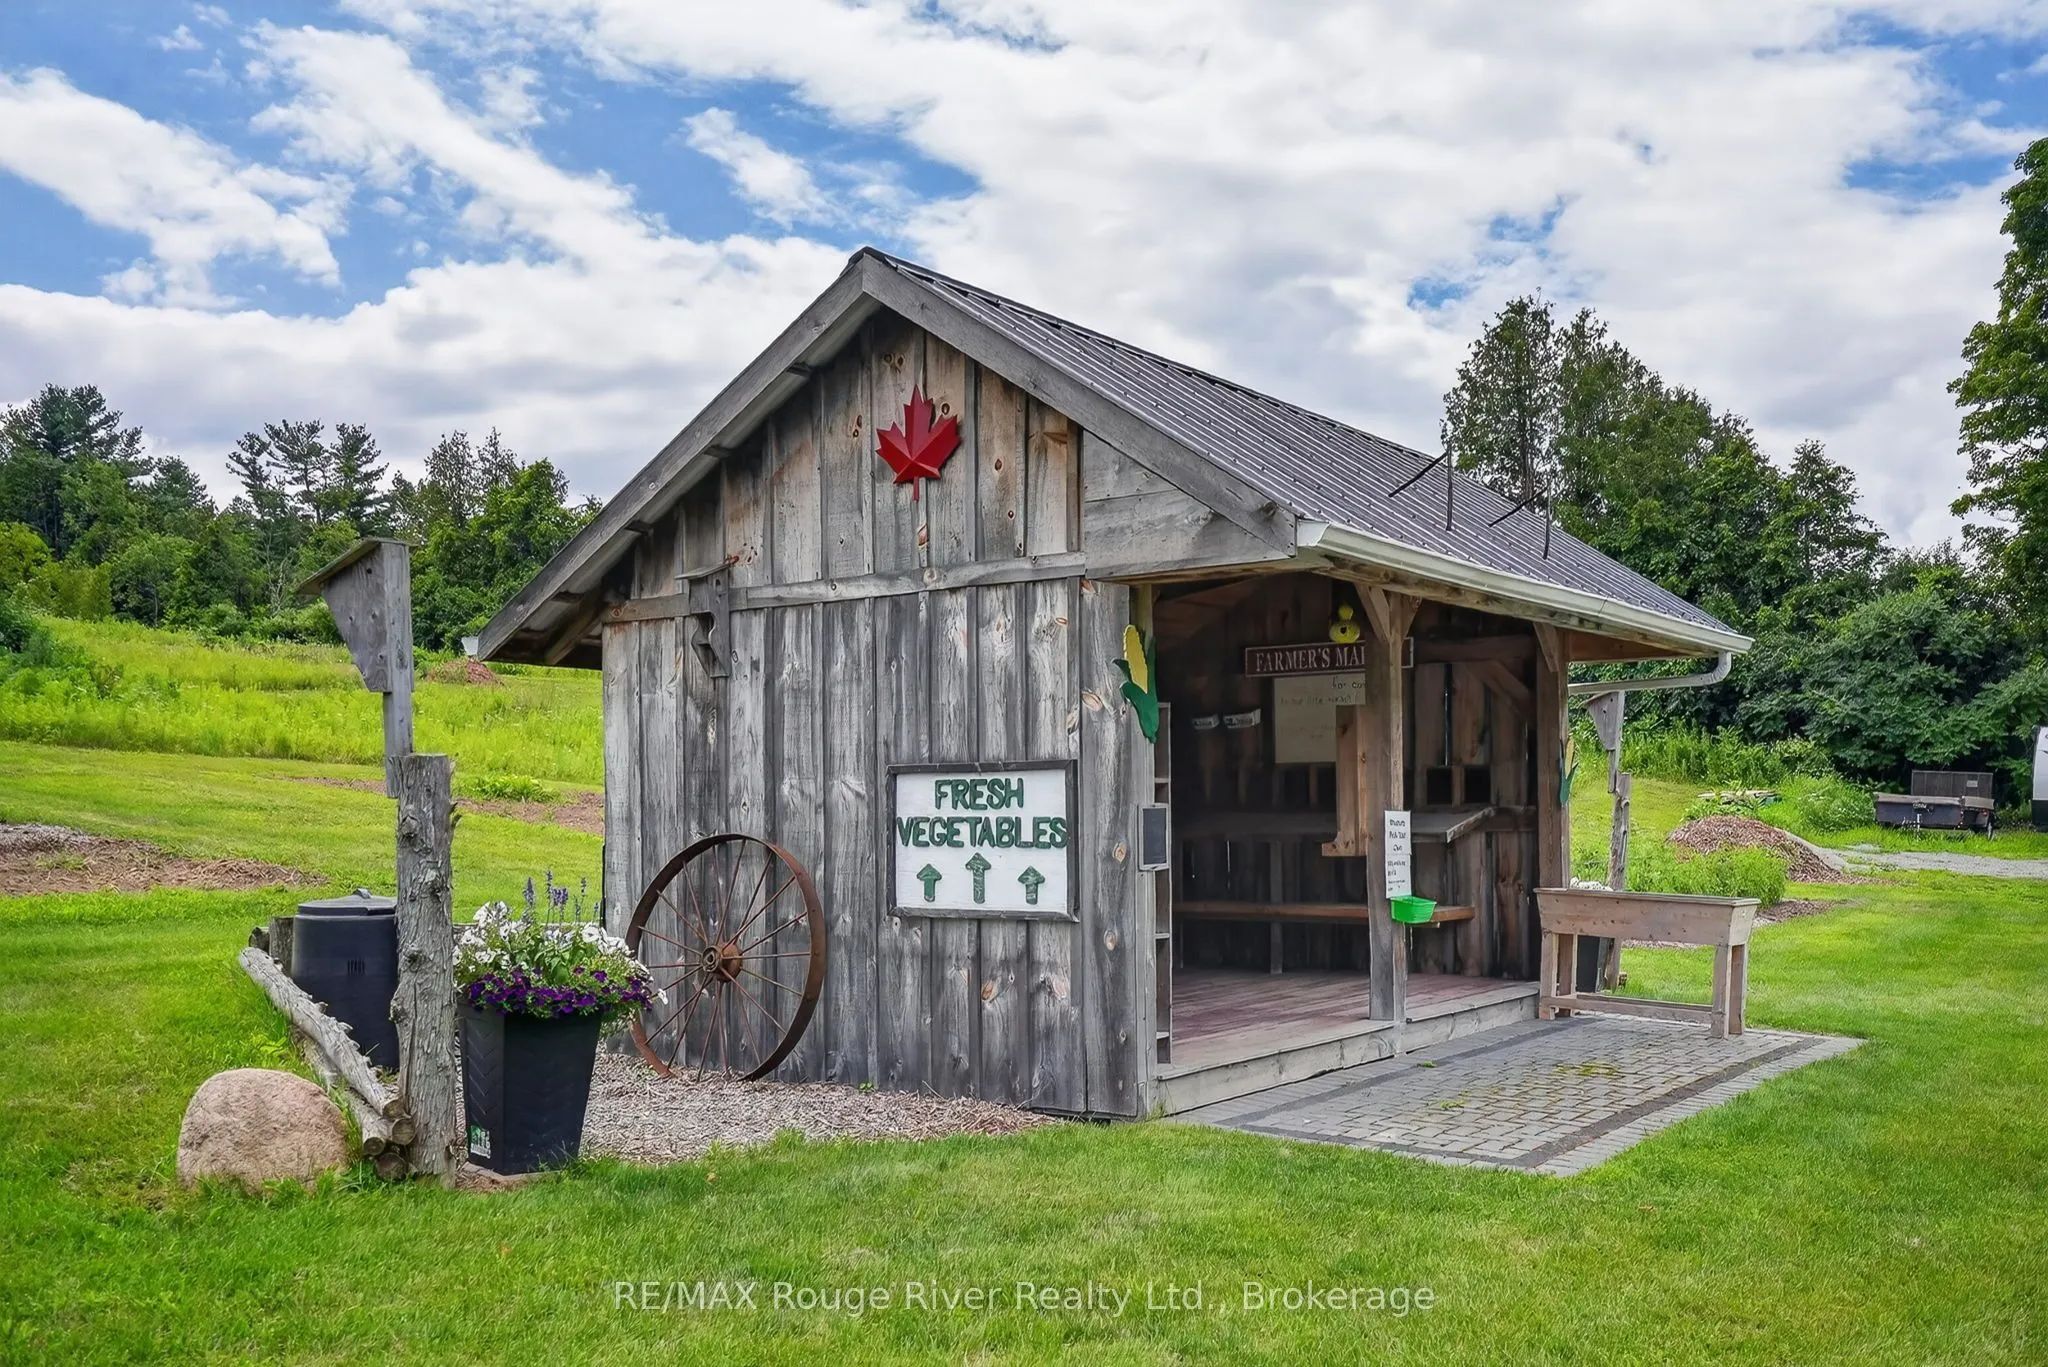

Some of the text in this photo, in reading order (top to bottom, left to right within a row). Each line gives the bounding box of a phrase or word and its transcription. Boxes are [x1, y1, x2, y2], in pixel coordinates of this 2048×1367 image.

[1255, 647, 1331, 672] FARMER'S
[934, 778, 1024, 811] FRESH
[896, 816, 1069, 849] VEGETABLES
